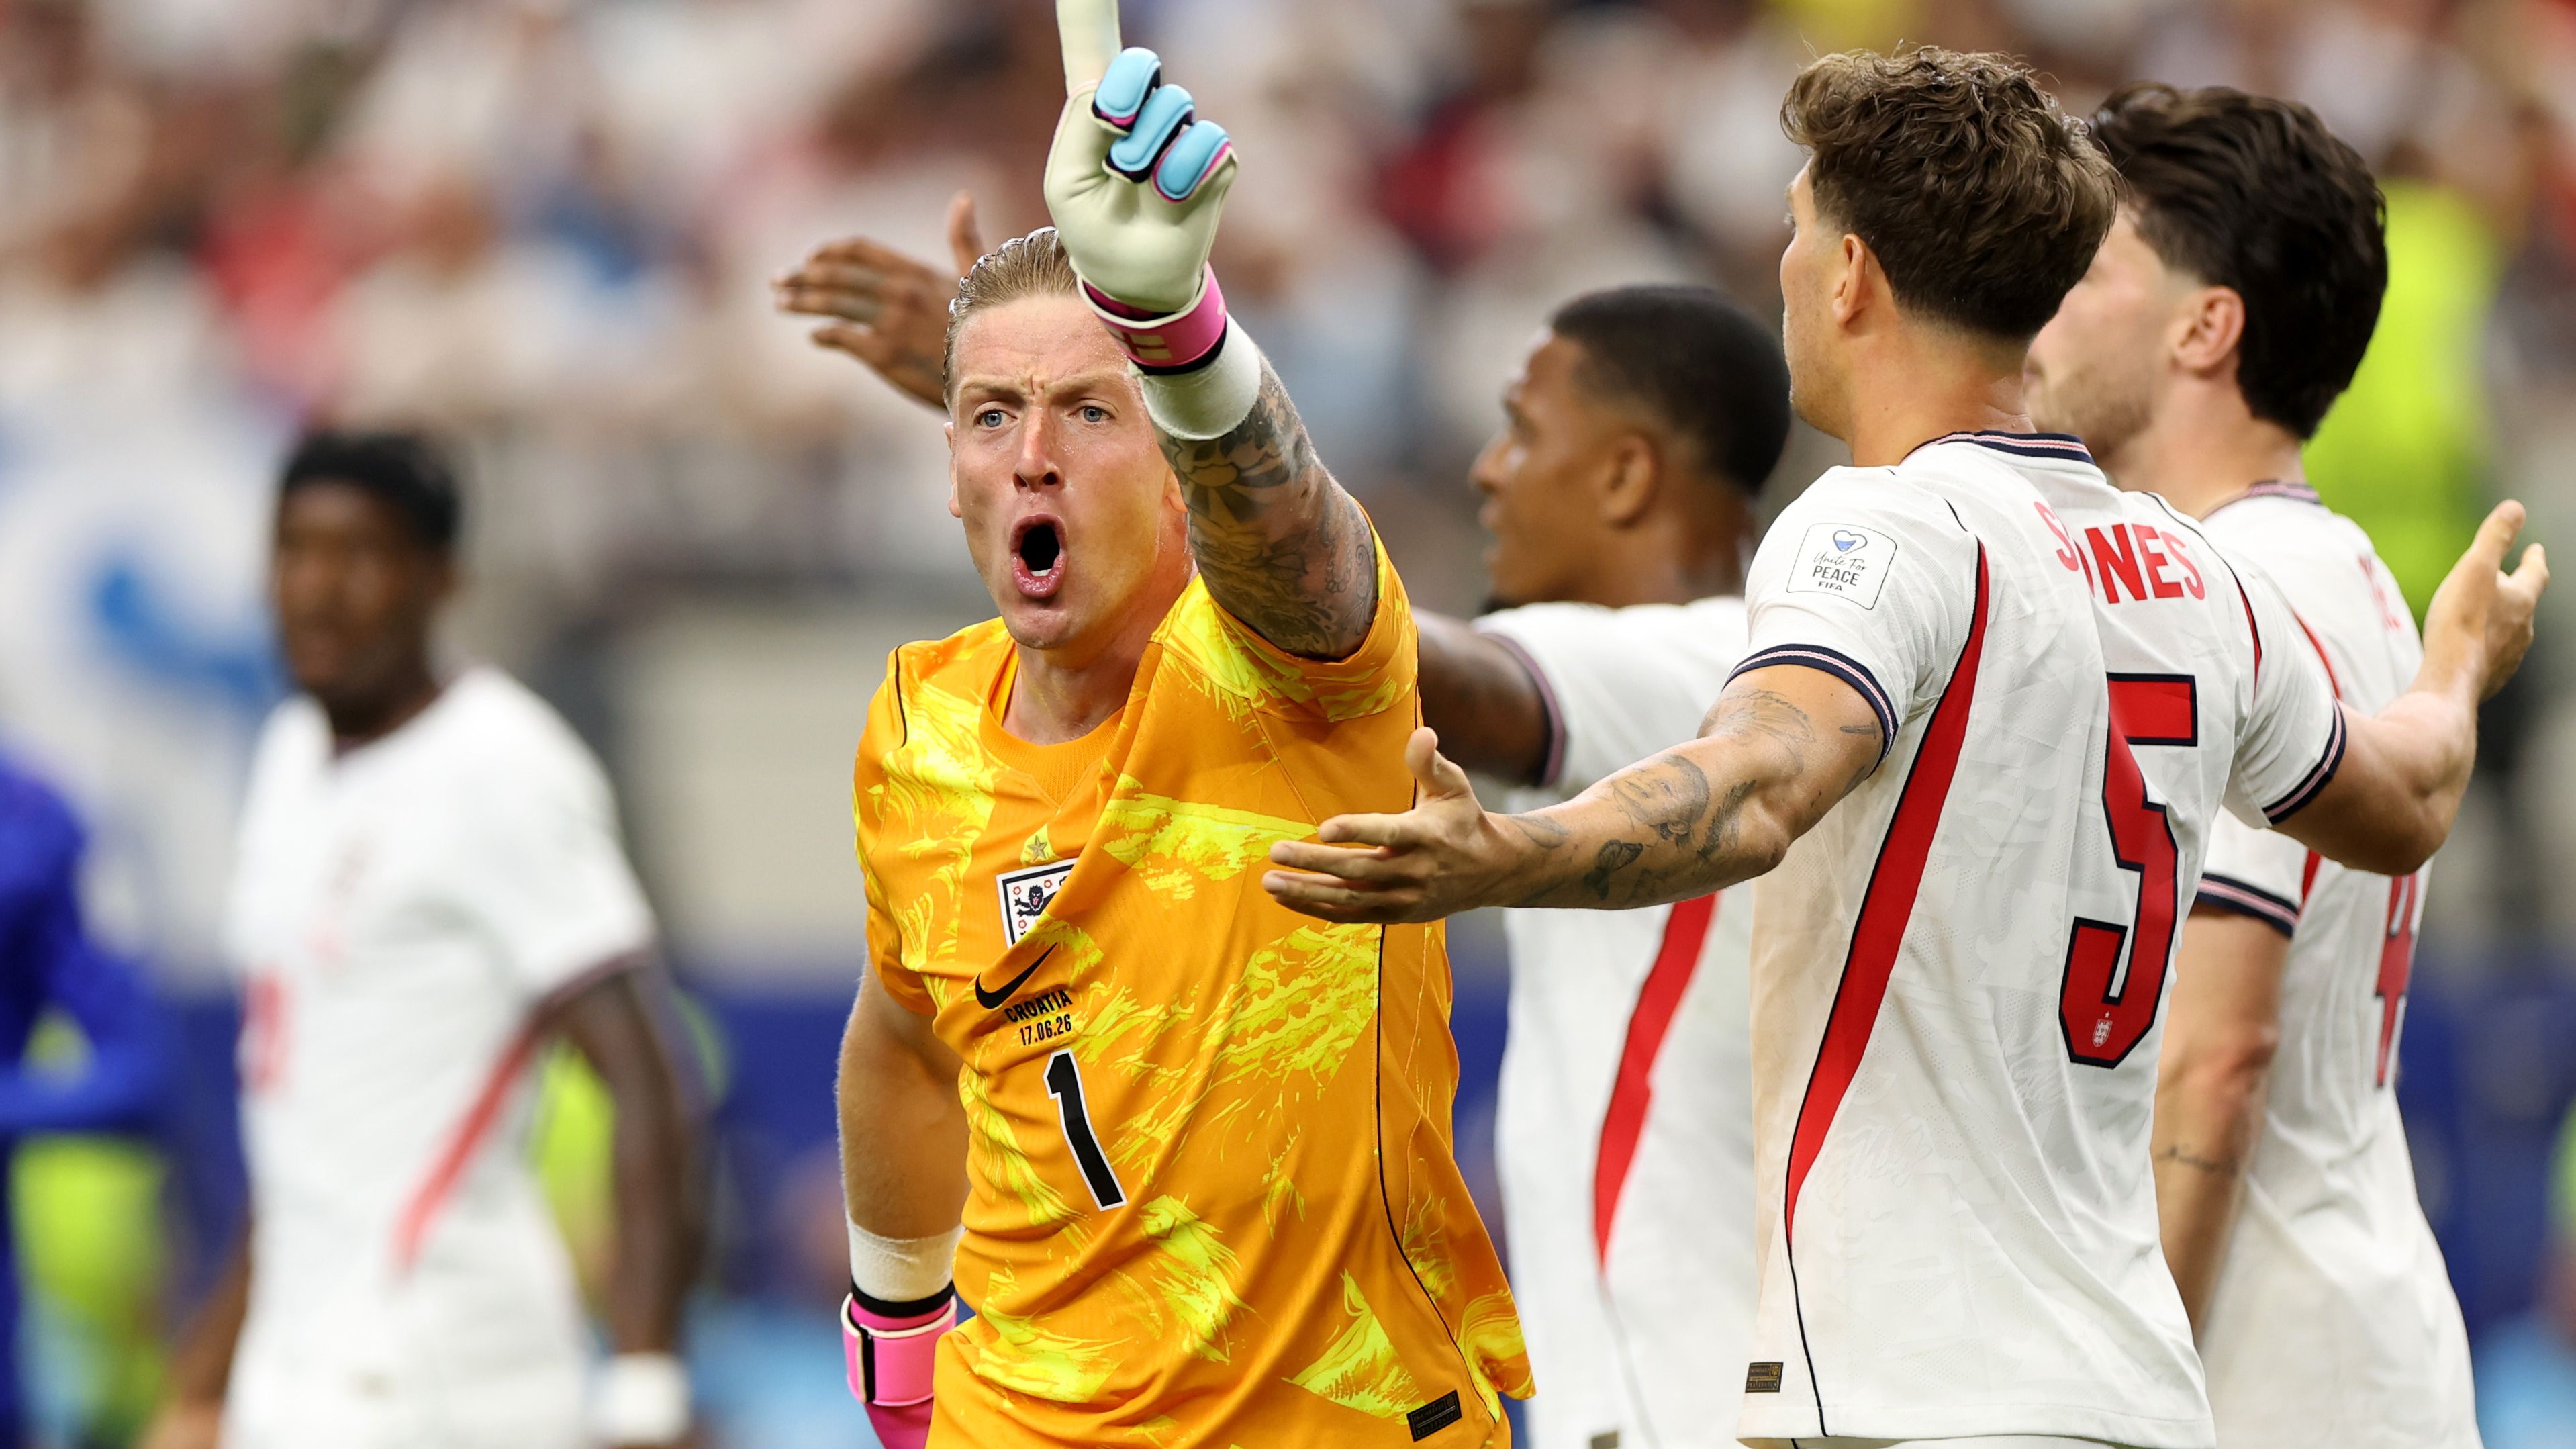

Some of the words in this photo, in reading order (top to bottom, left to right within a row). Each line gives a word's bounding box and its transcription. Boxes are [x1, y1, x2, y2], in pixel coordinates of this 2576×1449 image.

[1814, 551, 1846, 565] Unite
[1849, 558, 1866, 571] For
[2034, 502, 2205, 604] SNES
[1813, 565, 1860, 586] PEACE
[1818, 581, 1842, 591] FIFA
[2058, 671, 2197, 1069] 5
[1004, 990, 1073, 1022] CROATIA
[1020, 1014, 1071, 1045] 17.06.26
[1043, 1048, 1127, 1211] 1
